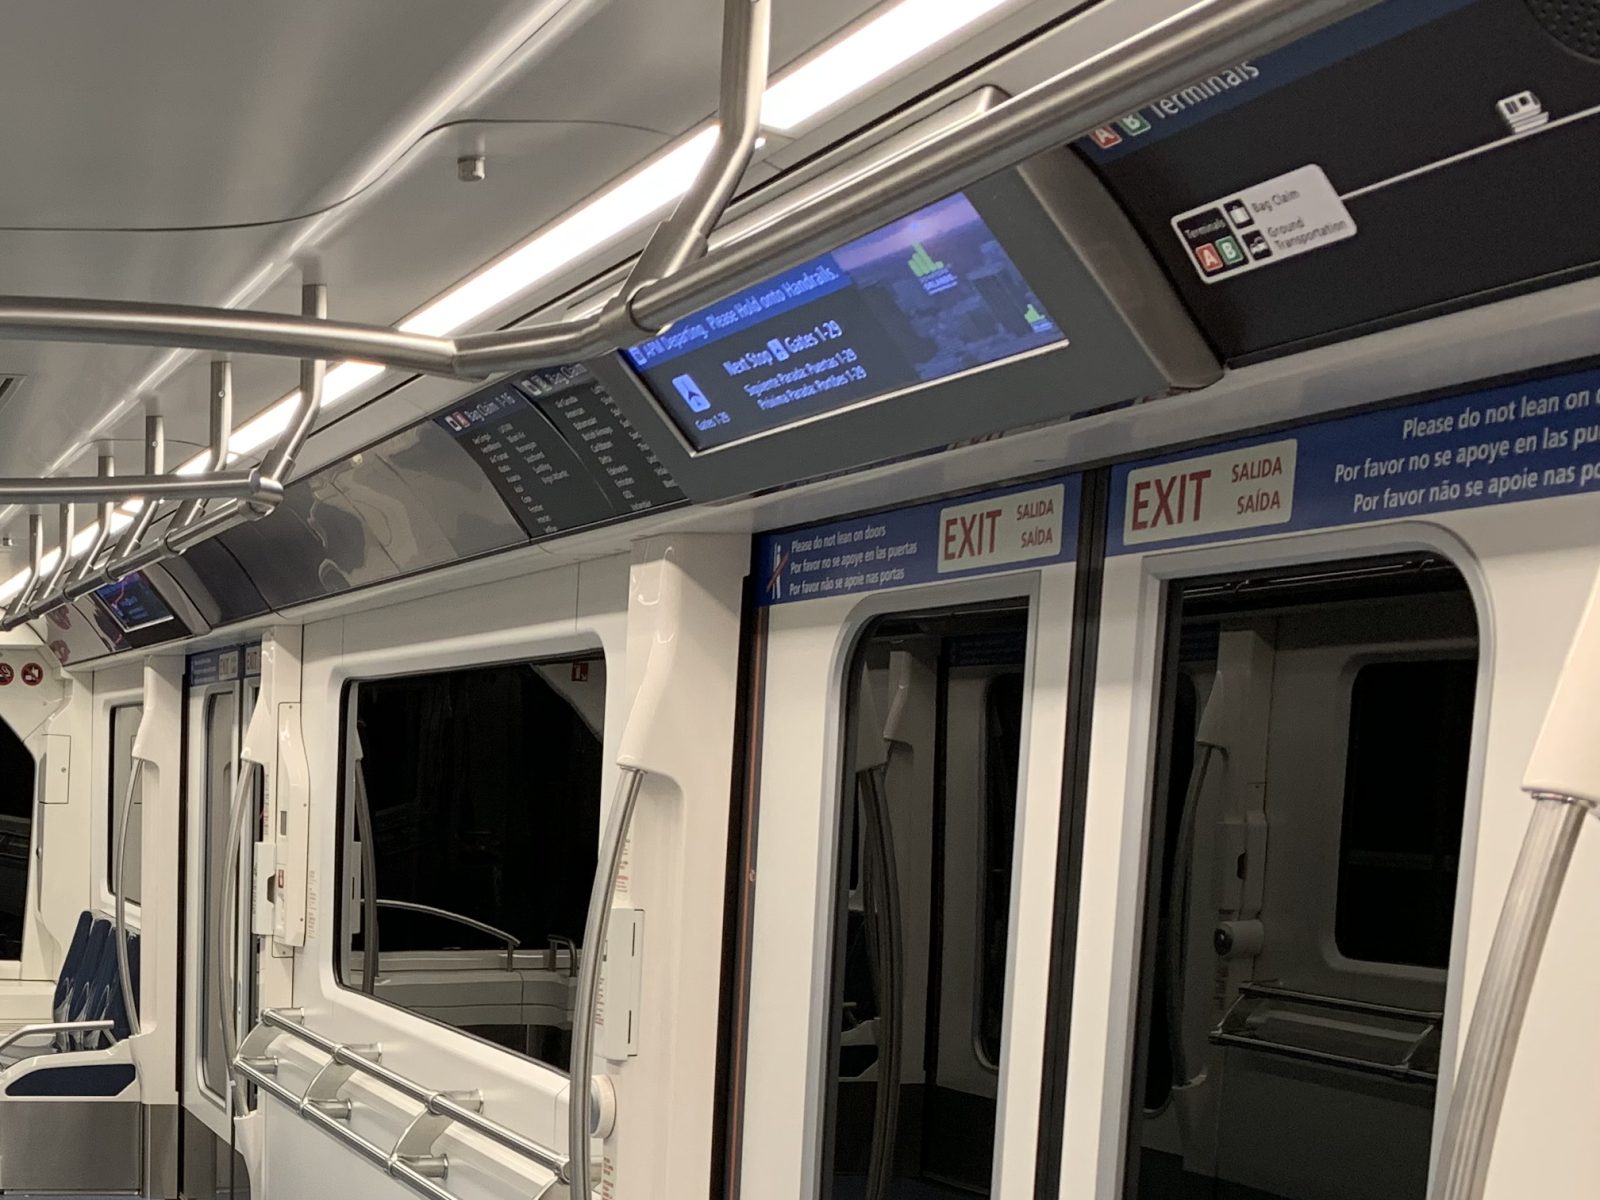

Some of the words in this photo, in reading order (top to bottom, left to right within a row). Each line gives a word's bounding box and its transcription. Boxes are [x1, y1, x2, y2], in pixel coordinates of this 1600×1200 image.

[1094, 127, 1115, 144] A
[1252, 200, 1273, 213] Bag
[1272, 189, 1300, 206] Claim
[1184, 218, 1227, 239] Terminals
[1267, 217, 1305, 238] Ground
[1274, 220, 1347, 250] Transportation
[1203, 249, 1216, 268] A
[1221, 241, 1237, 261] B
[705, 310, 739, 330] Please
[733, 296, 762, 319] Hold
[759, 288, 786, 308] onto
[781, 265, 839, 298] Handrails.
[722, 357, 752, 377] Next
[745, 349, 773, 367] Stop
[784, 331, 819, 353] Gates
[814, 319, 843, 341] 1-29
[835, 347, 858, 365] 1-29
[845, 365, 868, 383] 1-29
[695, 417, 717, 432] Gates
[1402, 417, 1454, 441] Please
[1458, 406, 1479, 430] do
[1485, 400, 1515, 424] not
[1521, 395, 1559, 418] lean
[1565, 390, 1590, 411] on
[1334, 463, 1361, 483] Por
[1364, 457, 1405, 479] favor
[1408, 452, 1430, 472] no
[1434, 450, 1452, 467] se
[1456, 440, 1510, 468] apoye
[1515, 435, 1537, 455] en
[1543, 427, 1568, 449] las
[1132, 469, 1211, 531] EXIT
[1231, 456, 1283, 484] SALIDA
[1236, 490, 1281, 516] SAÍDA
[1353, 493, 1379, 513] Por
[1383, 487, 1424, 510] favor
[1429, 480, 1460, 503] não
[1465, 479, 1484, 498] se
[1488, 467, 1538, 499] apoie
[1543, 464, 1576, 487] nas
[791, 538, 813, 553] Please
[813, 534, 823, 550] do
[823, 534, 836, 547] not
[837, 530, 852, 545] lean
[853, 530, 864, 542] on
[864, 523, 886, 539] doors
[943, 508, 1002, 561] EXIT
[1016, 498, 1054, 521] SALIDA
[1021, 526, 1053, 549] SAÍDA
[790, 560, 802, 575] Por
[802, 556, 821, 573] favor
[821, 557, 831, 570] no
[841, 551, 863, 568] apoye
[864, 550, 875, 562] en
[875, 545, 887, 560] las
[887, 541, 918, 561] puertas
[789, 583, 801, 597] Por
[801, 578, 820, 594] favor
[820, 576, 834, 591] não
[843, 571, 864, 590] apoie
[865, 571, 879, 584] nas
[879, 567, 905, 585] portas
